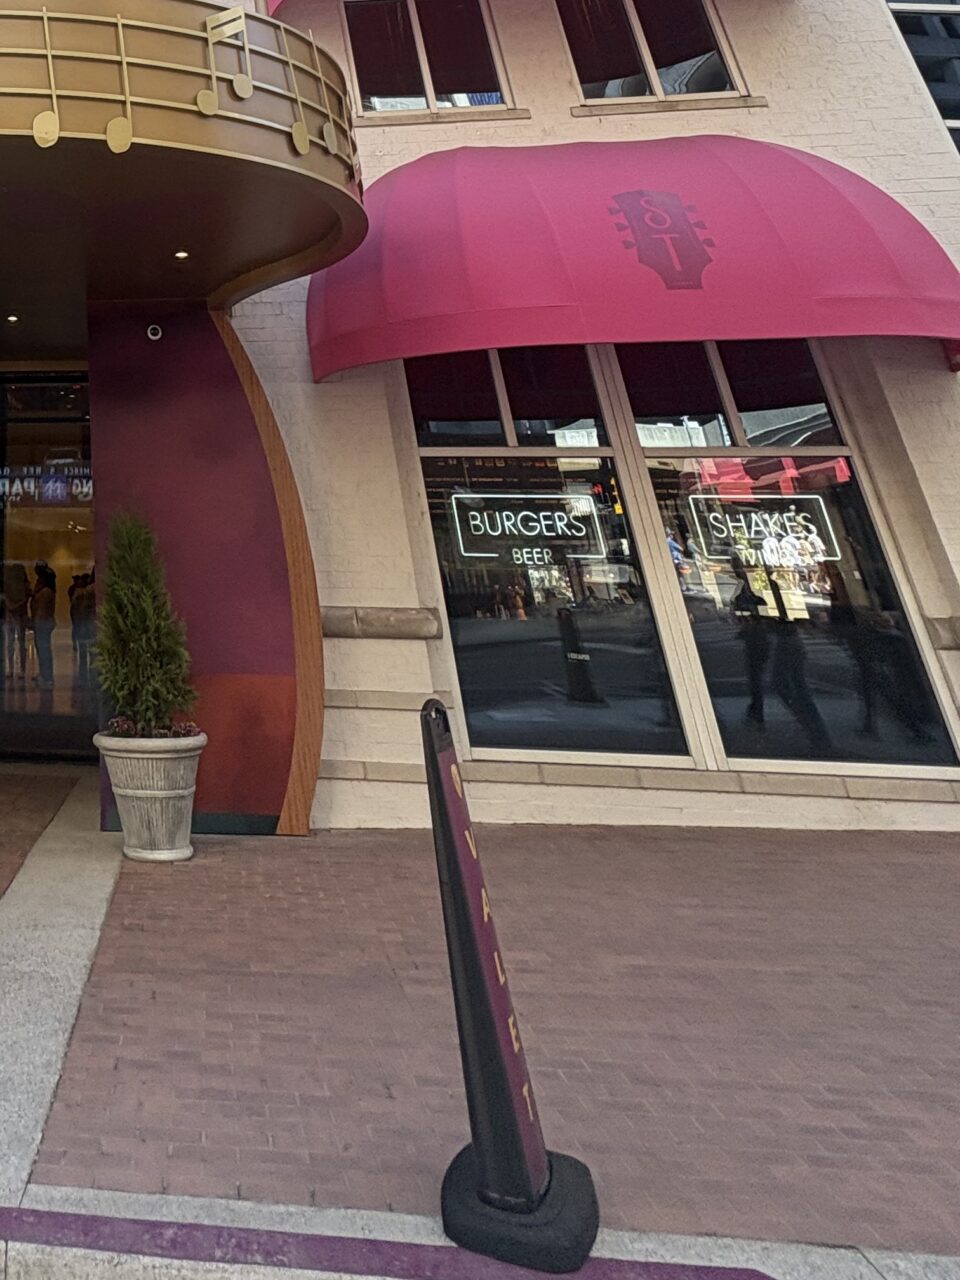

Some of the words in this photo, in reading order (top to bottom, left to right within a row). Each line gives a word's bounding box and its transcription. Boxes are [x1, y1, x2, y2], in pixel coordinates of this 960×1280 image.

[468, 511, 586, 536] BURGERS
[709, 512, 817, 538] SHAKES
[511, 548, 553, 565] BEER
[464, 827, 534, 1121] VALET
